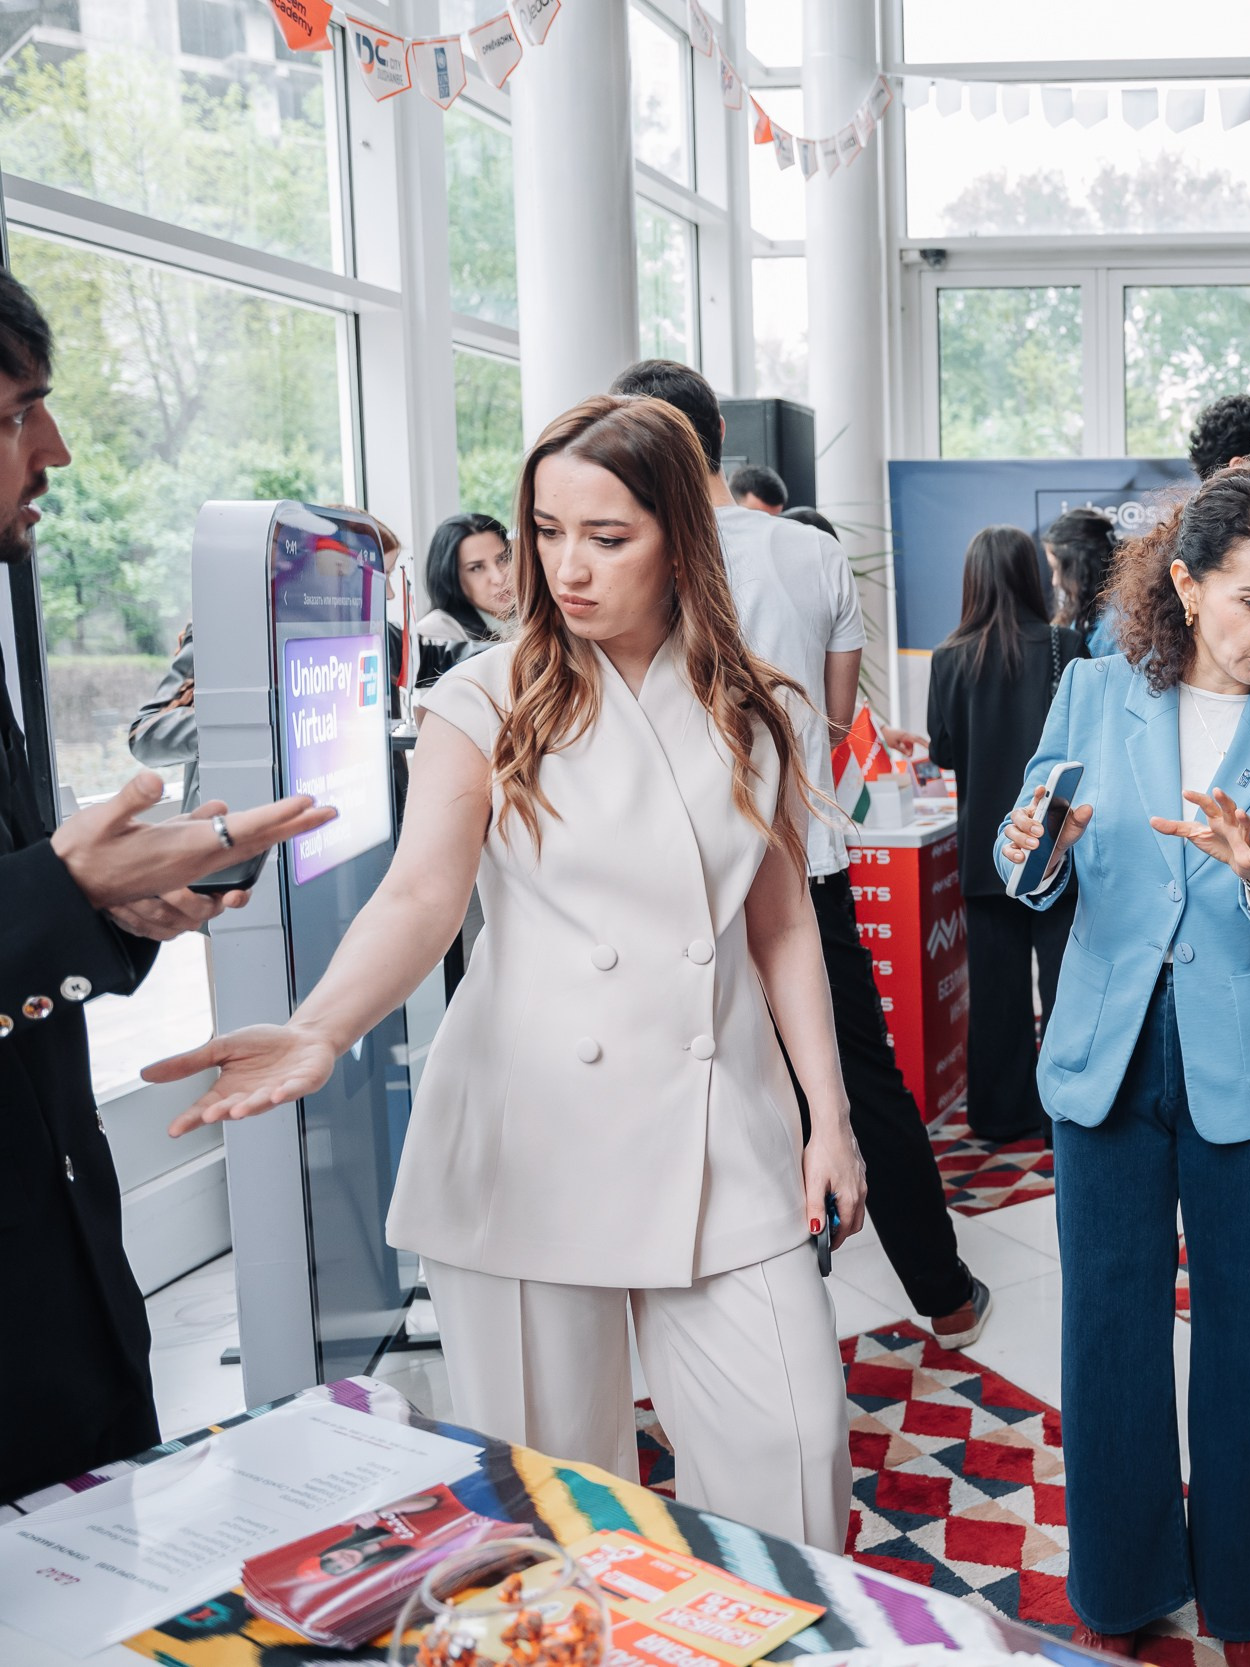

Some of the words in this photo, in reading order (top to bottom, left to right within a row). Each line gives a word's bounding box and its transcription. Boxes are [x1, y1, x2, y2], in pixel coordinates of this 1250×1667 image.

[268, 0, 313, 36] cademy
[285, 540, 297, 555] 9:41
[291, 655, 352, 698] UnionPay
[292, 703, 337, 749] Virtual
